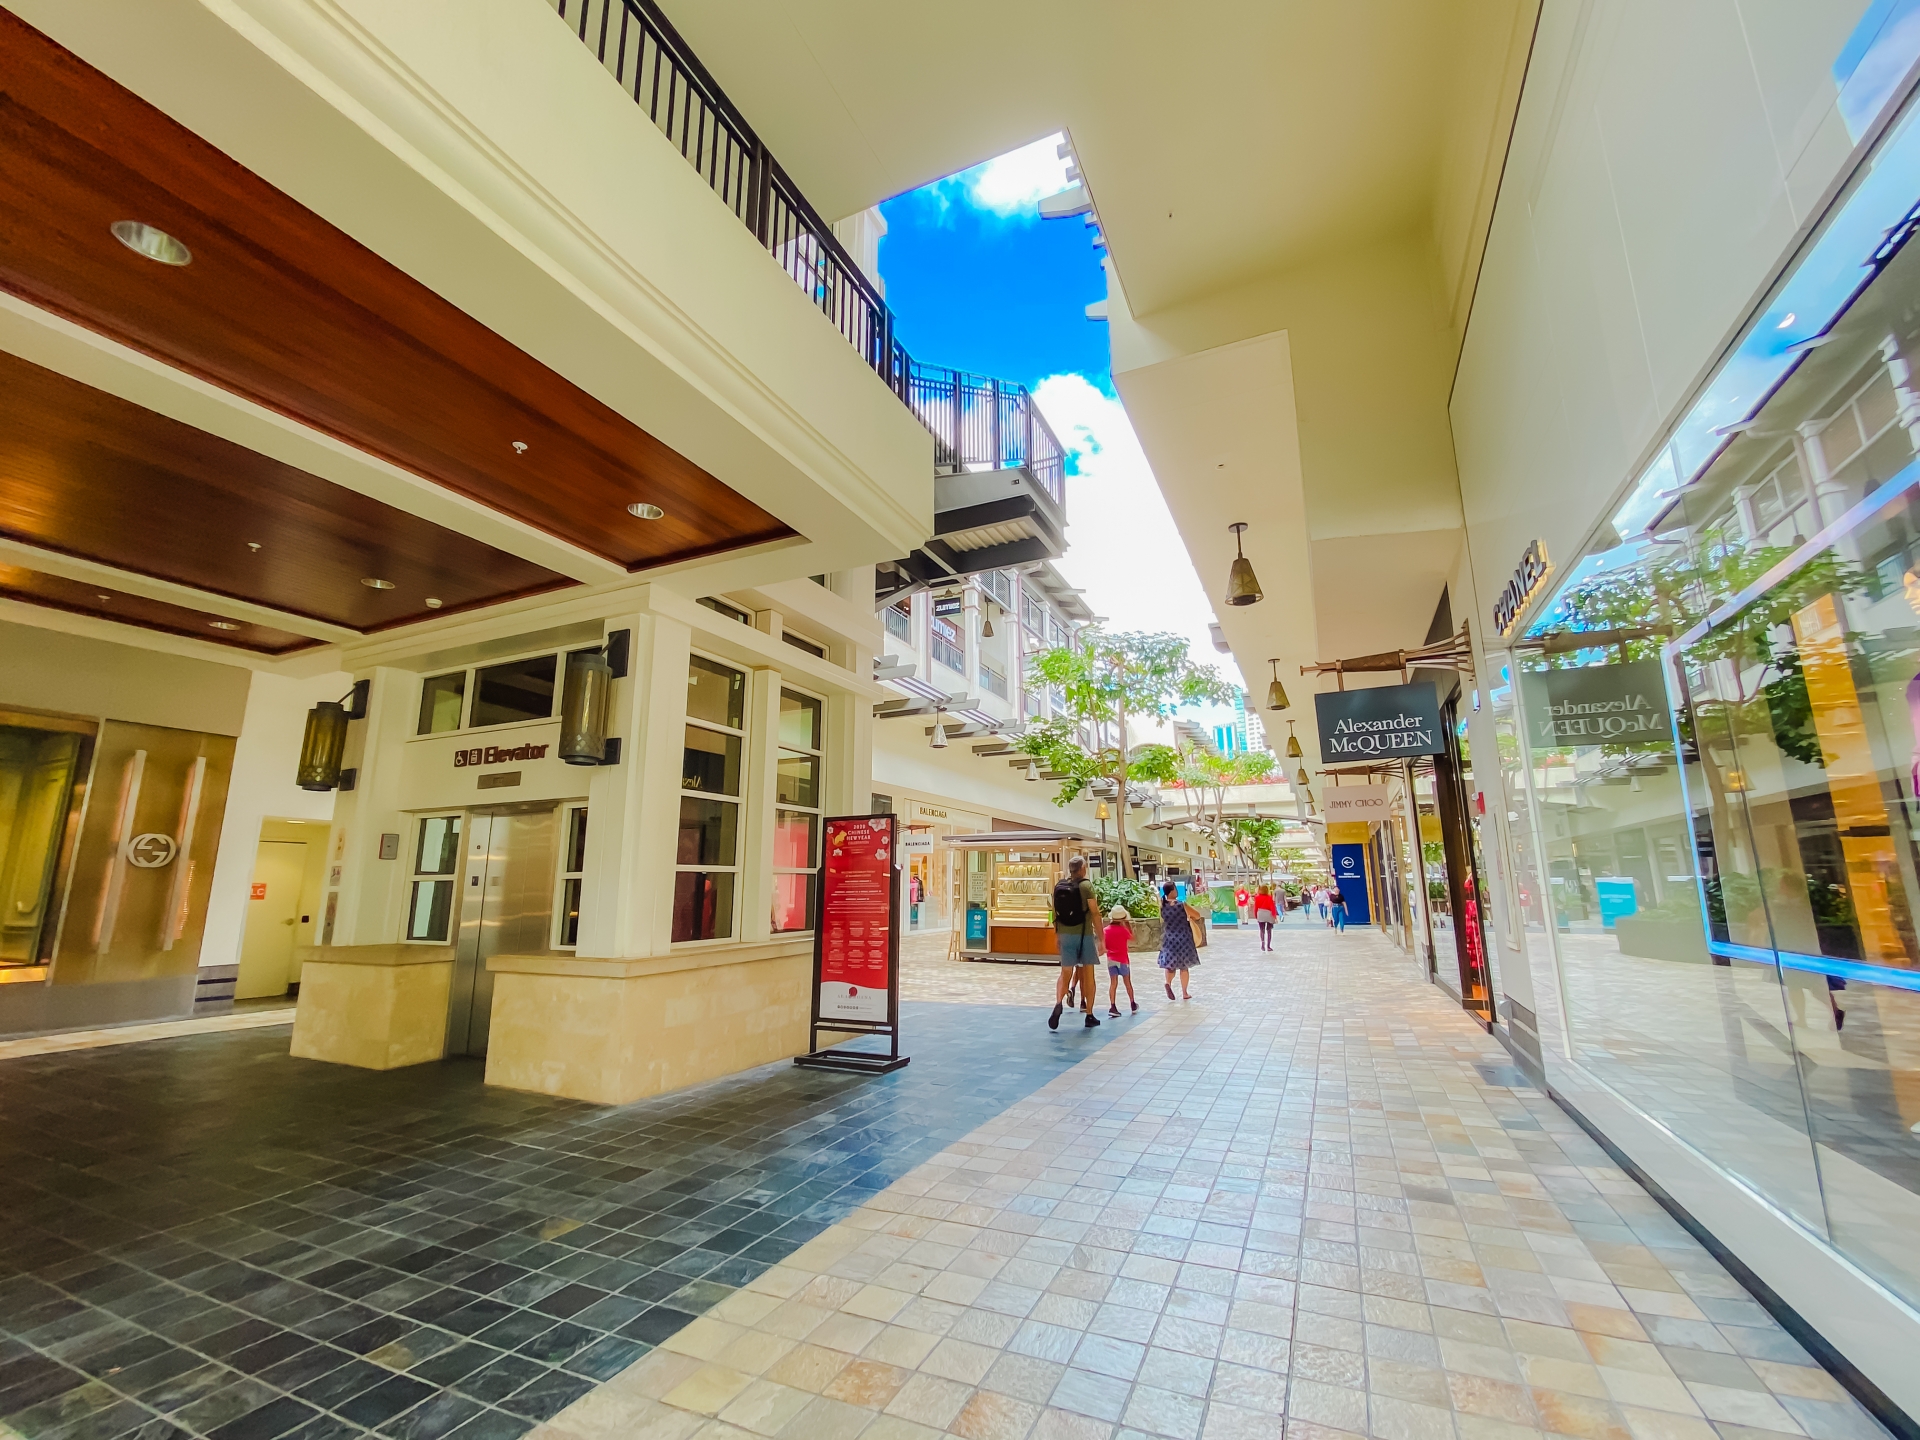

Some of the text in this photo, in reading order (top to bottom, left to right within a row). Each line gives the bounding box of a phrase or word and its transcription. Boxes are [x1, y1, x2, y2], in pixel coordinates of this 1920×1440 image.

[1493, 540, 1547, 636] CHANEL
[1333, 713, 1423, 734] Alexander
[1329, 729, 1433, 755] McQUEEN
[483, 743, 549, 765] Elevator
[919, 806, 948, 819] BALENCIAGA
[1329, 798, 1384, 809] JIMMY CHOO
